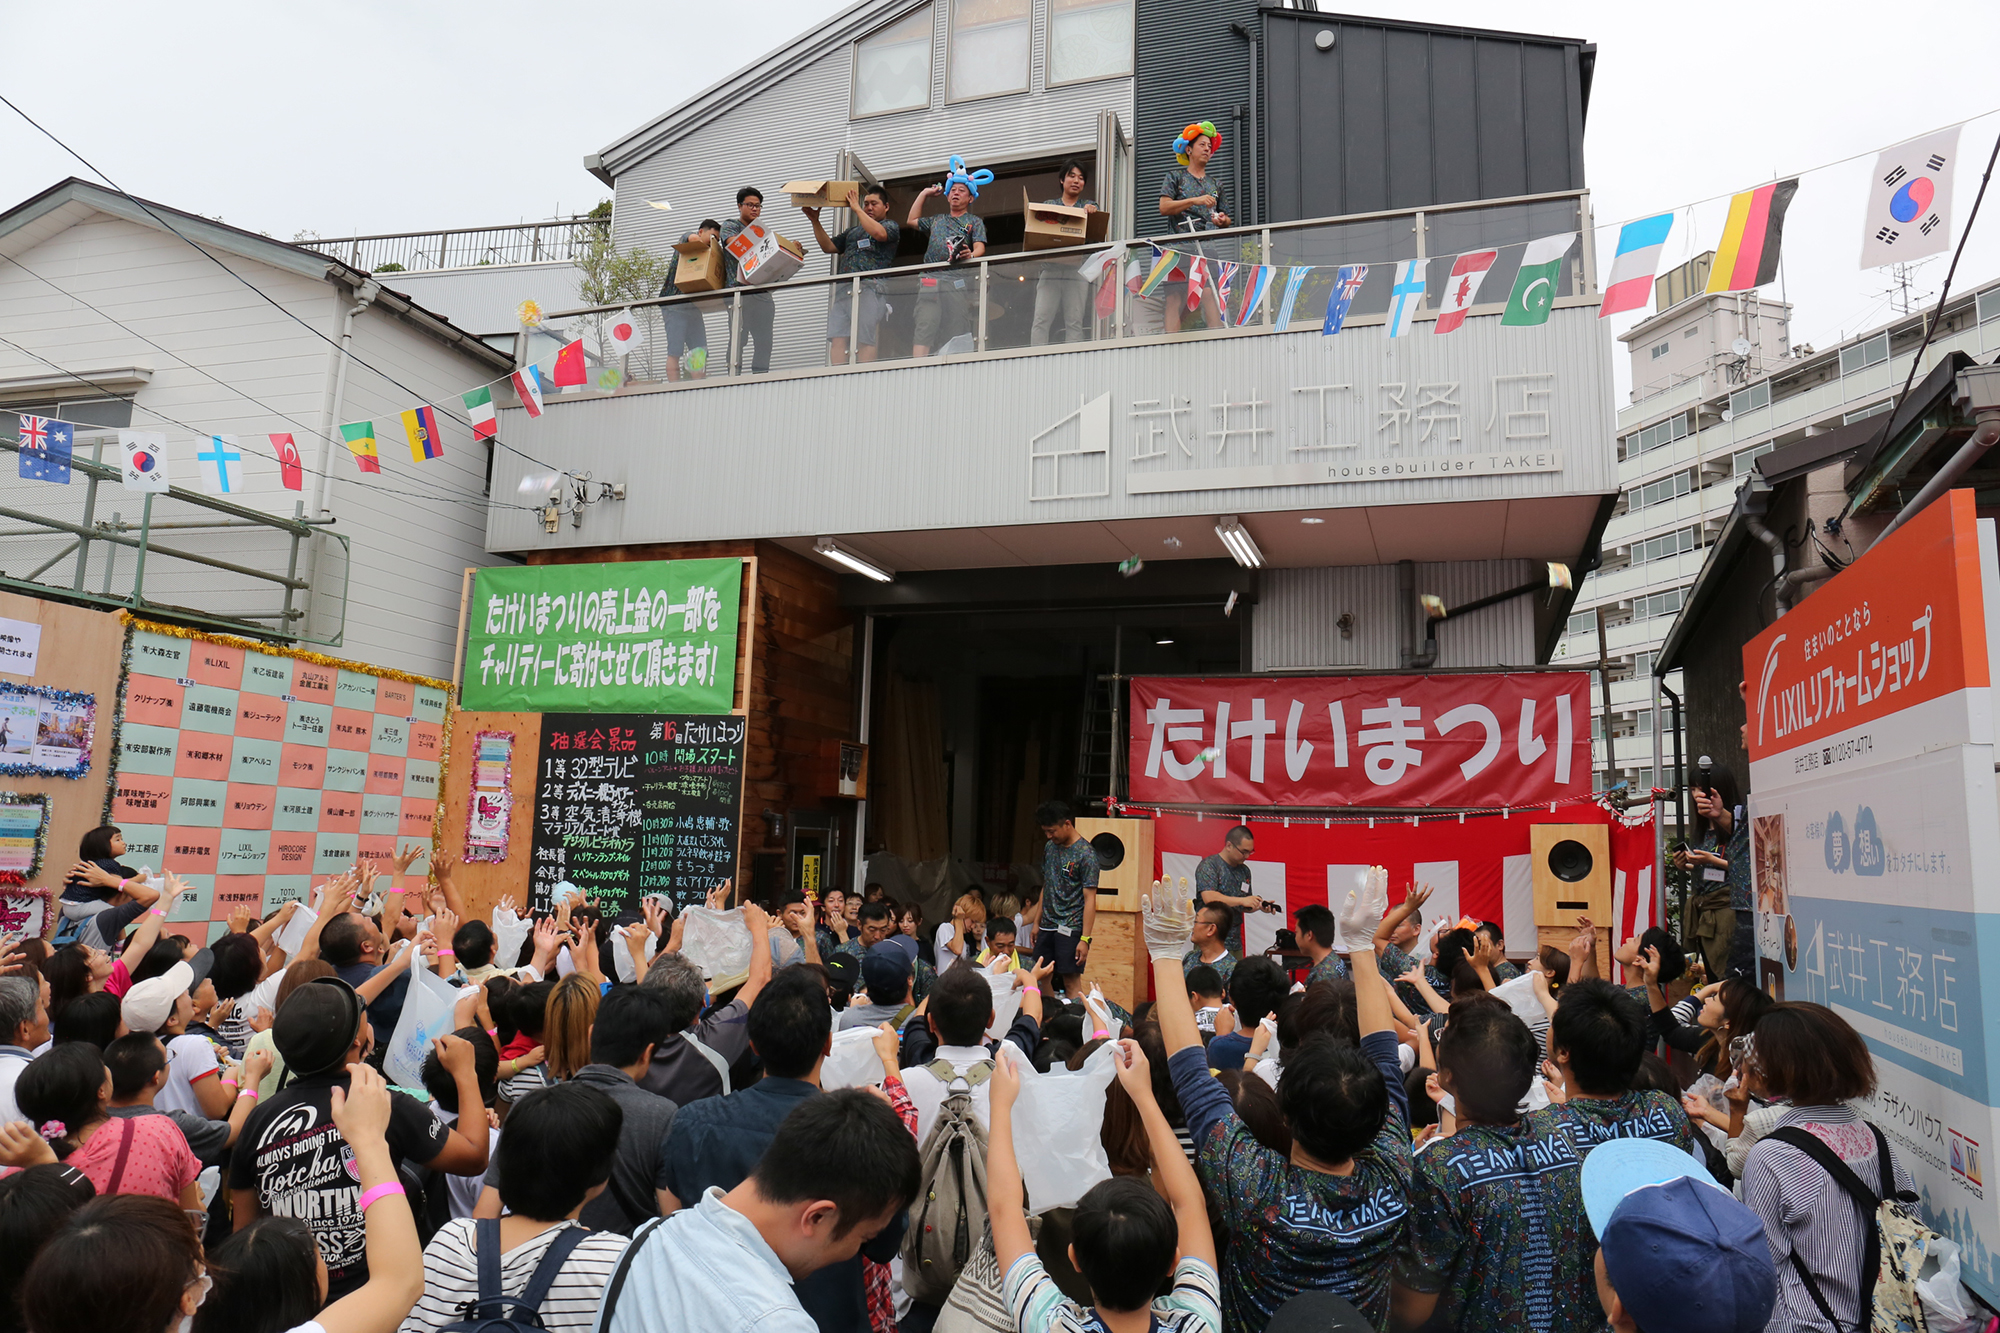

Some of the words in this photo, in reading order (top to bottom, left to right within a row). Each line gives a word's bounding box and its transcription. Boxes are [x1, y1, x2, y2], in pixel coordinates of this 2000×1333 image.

[1128, 369, 1555, 461] 武井工務店
[1328, 458, 1475, 478] housebuilder
[1489, 456, 1556, 469] TAKEI
[485, 586, 721, 635] たけいまつりの売上金の一部を
[1804, 601, 1871, 662] 住まいのことなら
[480, 639, 718, 688] チャリティーに寄付させて頂きます!
[550, 727, 637, 752] 抽選会景品
[684, 721, 744, 744] たけいまつり
[1144, 693, 1573, 786] たけいまつり
[645, 750, 668, 765] 10時
[1832, 735, 1873, 763] 0120-57-4774
[545, 758, 566, 779] 1等
[571, 755, 638, 779] 32型テレビ
[542, 783, 563, 800] 2等
[540, 804, 559, 820] 3等
[611, 799, 635, 809] チケット
[125, 843, 159, 854] 井工務店
[238, 843, 253, 852] LIXIL
[278, 845, 307, 853] HIROCORE
[563, 833, 635, 852] デジタルビデオカメラ
[1832, 831, 1843, 866] 夢
[1859, 830, 1880, 866] 想い
[221, 852, 266, 860] リフォームショップ
[281, 853, 302, 861] DESIGN
[536, 846, 566, 864] 社長賞
[676, 860, 715, 873] もちつき
[1887, 851, 1951, 875] をカタチにします。
[535, 882, 556, 895] 協力
[1828, 930, 1958, 1033] 武井工務店
[1884, 1026, 1931, 1056] housebuilder
[1935, 1045, 1960, 1068] TAKEI
[1556, 1121, 1617, 1142] TEAM
[257, 1146, 291, 1168] ALWAYS
[293, 1132, 325, 1156] RIDING
[327, 1128, 343, 1143] TH
[1447, 1144, 1526, 1179] TEAM
[258, 1145, 341, 1208] Gotcha
[272, 1186, 364, 1219] WORTHY
[1286, 1194, 1343, 1230] TEAM
[303, 1219, 334, 1228] Since
[337, 1212, 364, 1225] 1978
[315, 1231, 343, 1254] SS
[321, 1253, 344, 1263] TION
